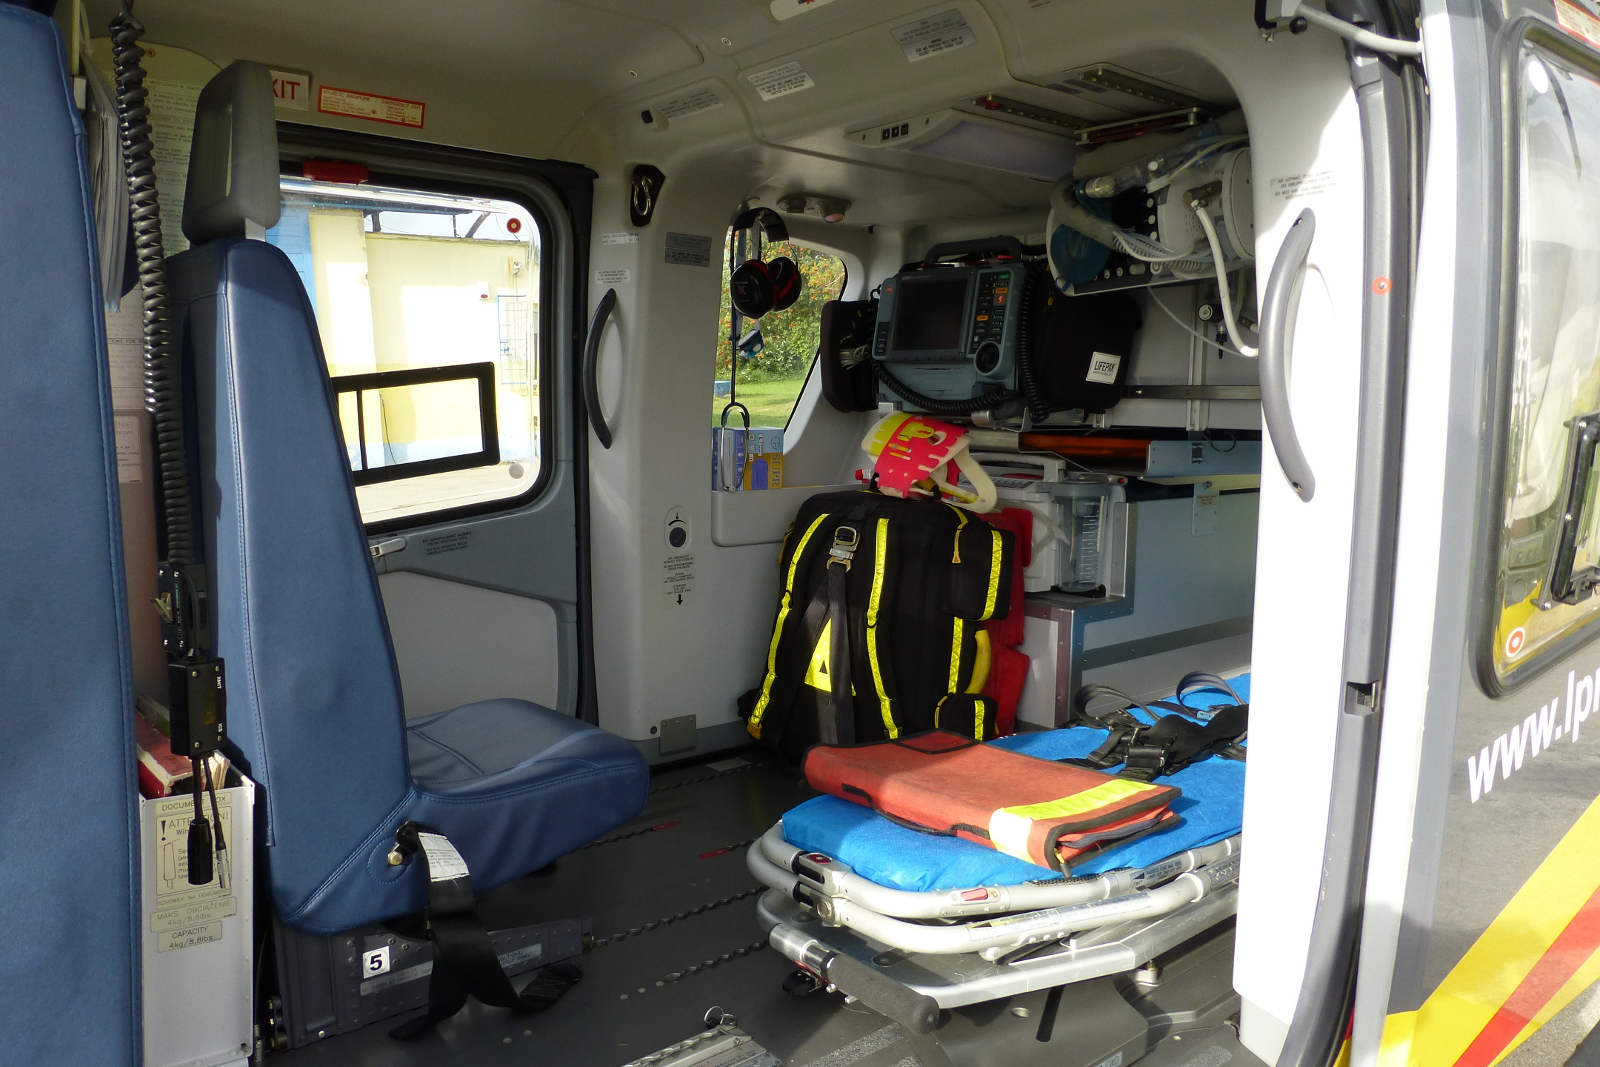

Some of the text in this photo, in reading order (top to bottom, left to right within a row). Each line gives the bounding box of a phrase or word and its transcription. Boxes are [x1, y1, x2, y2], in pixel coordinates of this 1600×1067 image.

[272, 79, 300, 100] XIT
[1094, 360, 1116, 373] LIFEPAK
[162, 796, 226, 812] DOCUMET OX
[157, 910, 179, 920] MAKS
[171, 925, 209, 939] CAPACITY
[370, 953, 383, 971] 5
